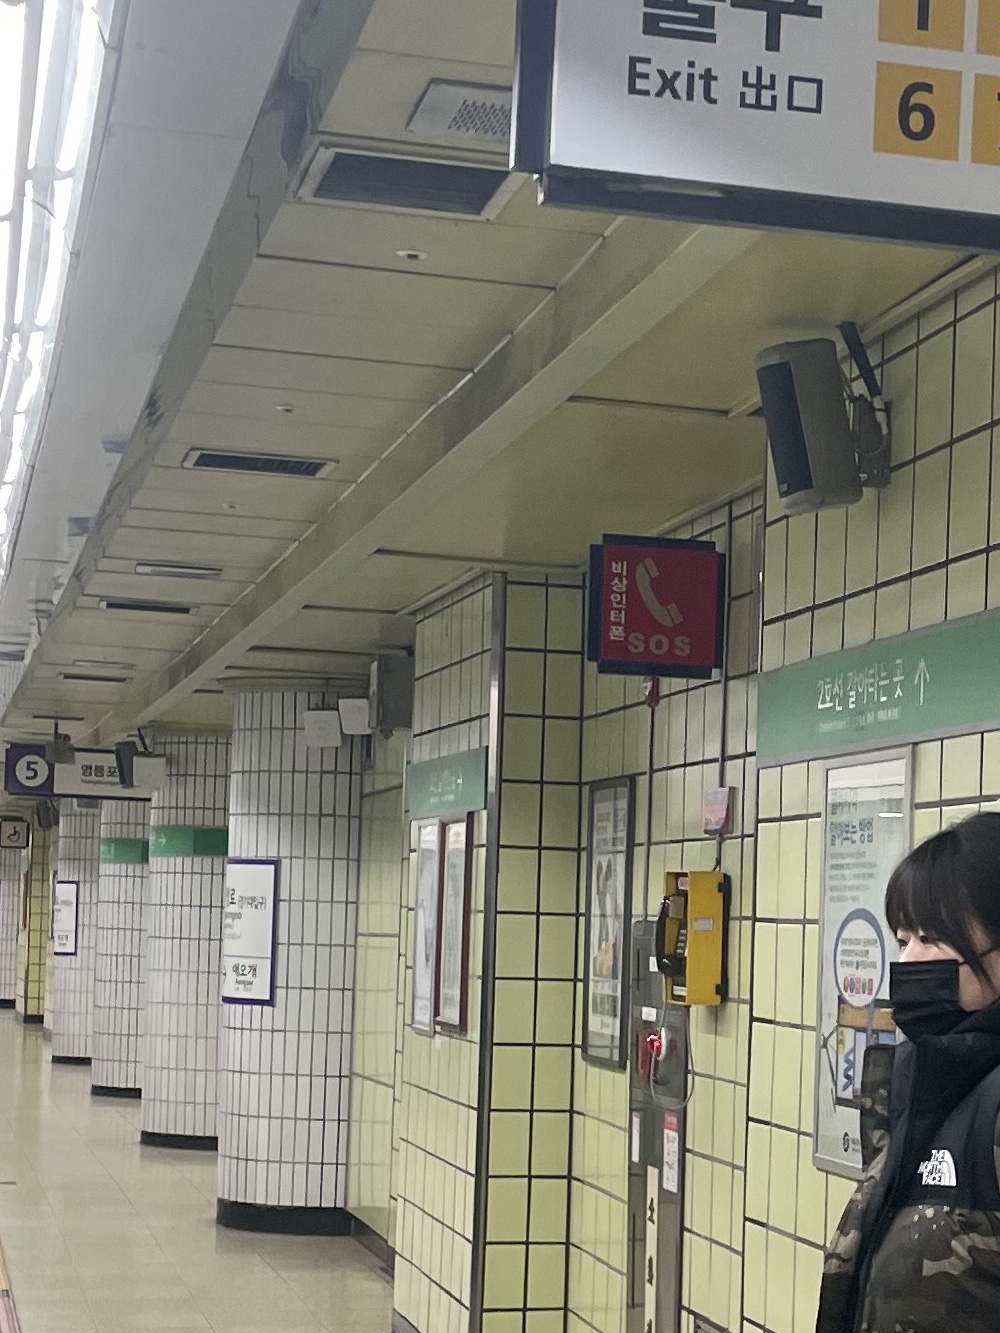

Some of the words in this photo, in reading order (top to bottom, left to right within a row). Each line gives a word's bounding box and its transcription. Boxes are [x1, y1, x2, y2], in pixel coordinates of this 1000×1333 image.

[628, 55, 718, 105] Exit
[740, 65, 823, 115] 出口
[899, 82, 936, 142] 6
[608, 560, 629, 641] 비상인터폰
[627, 632, 691, 657] SOS
[847, 663, 889, 709] 갈아타는
[25, 761, 39, 780] 5
